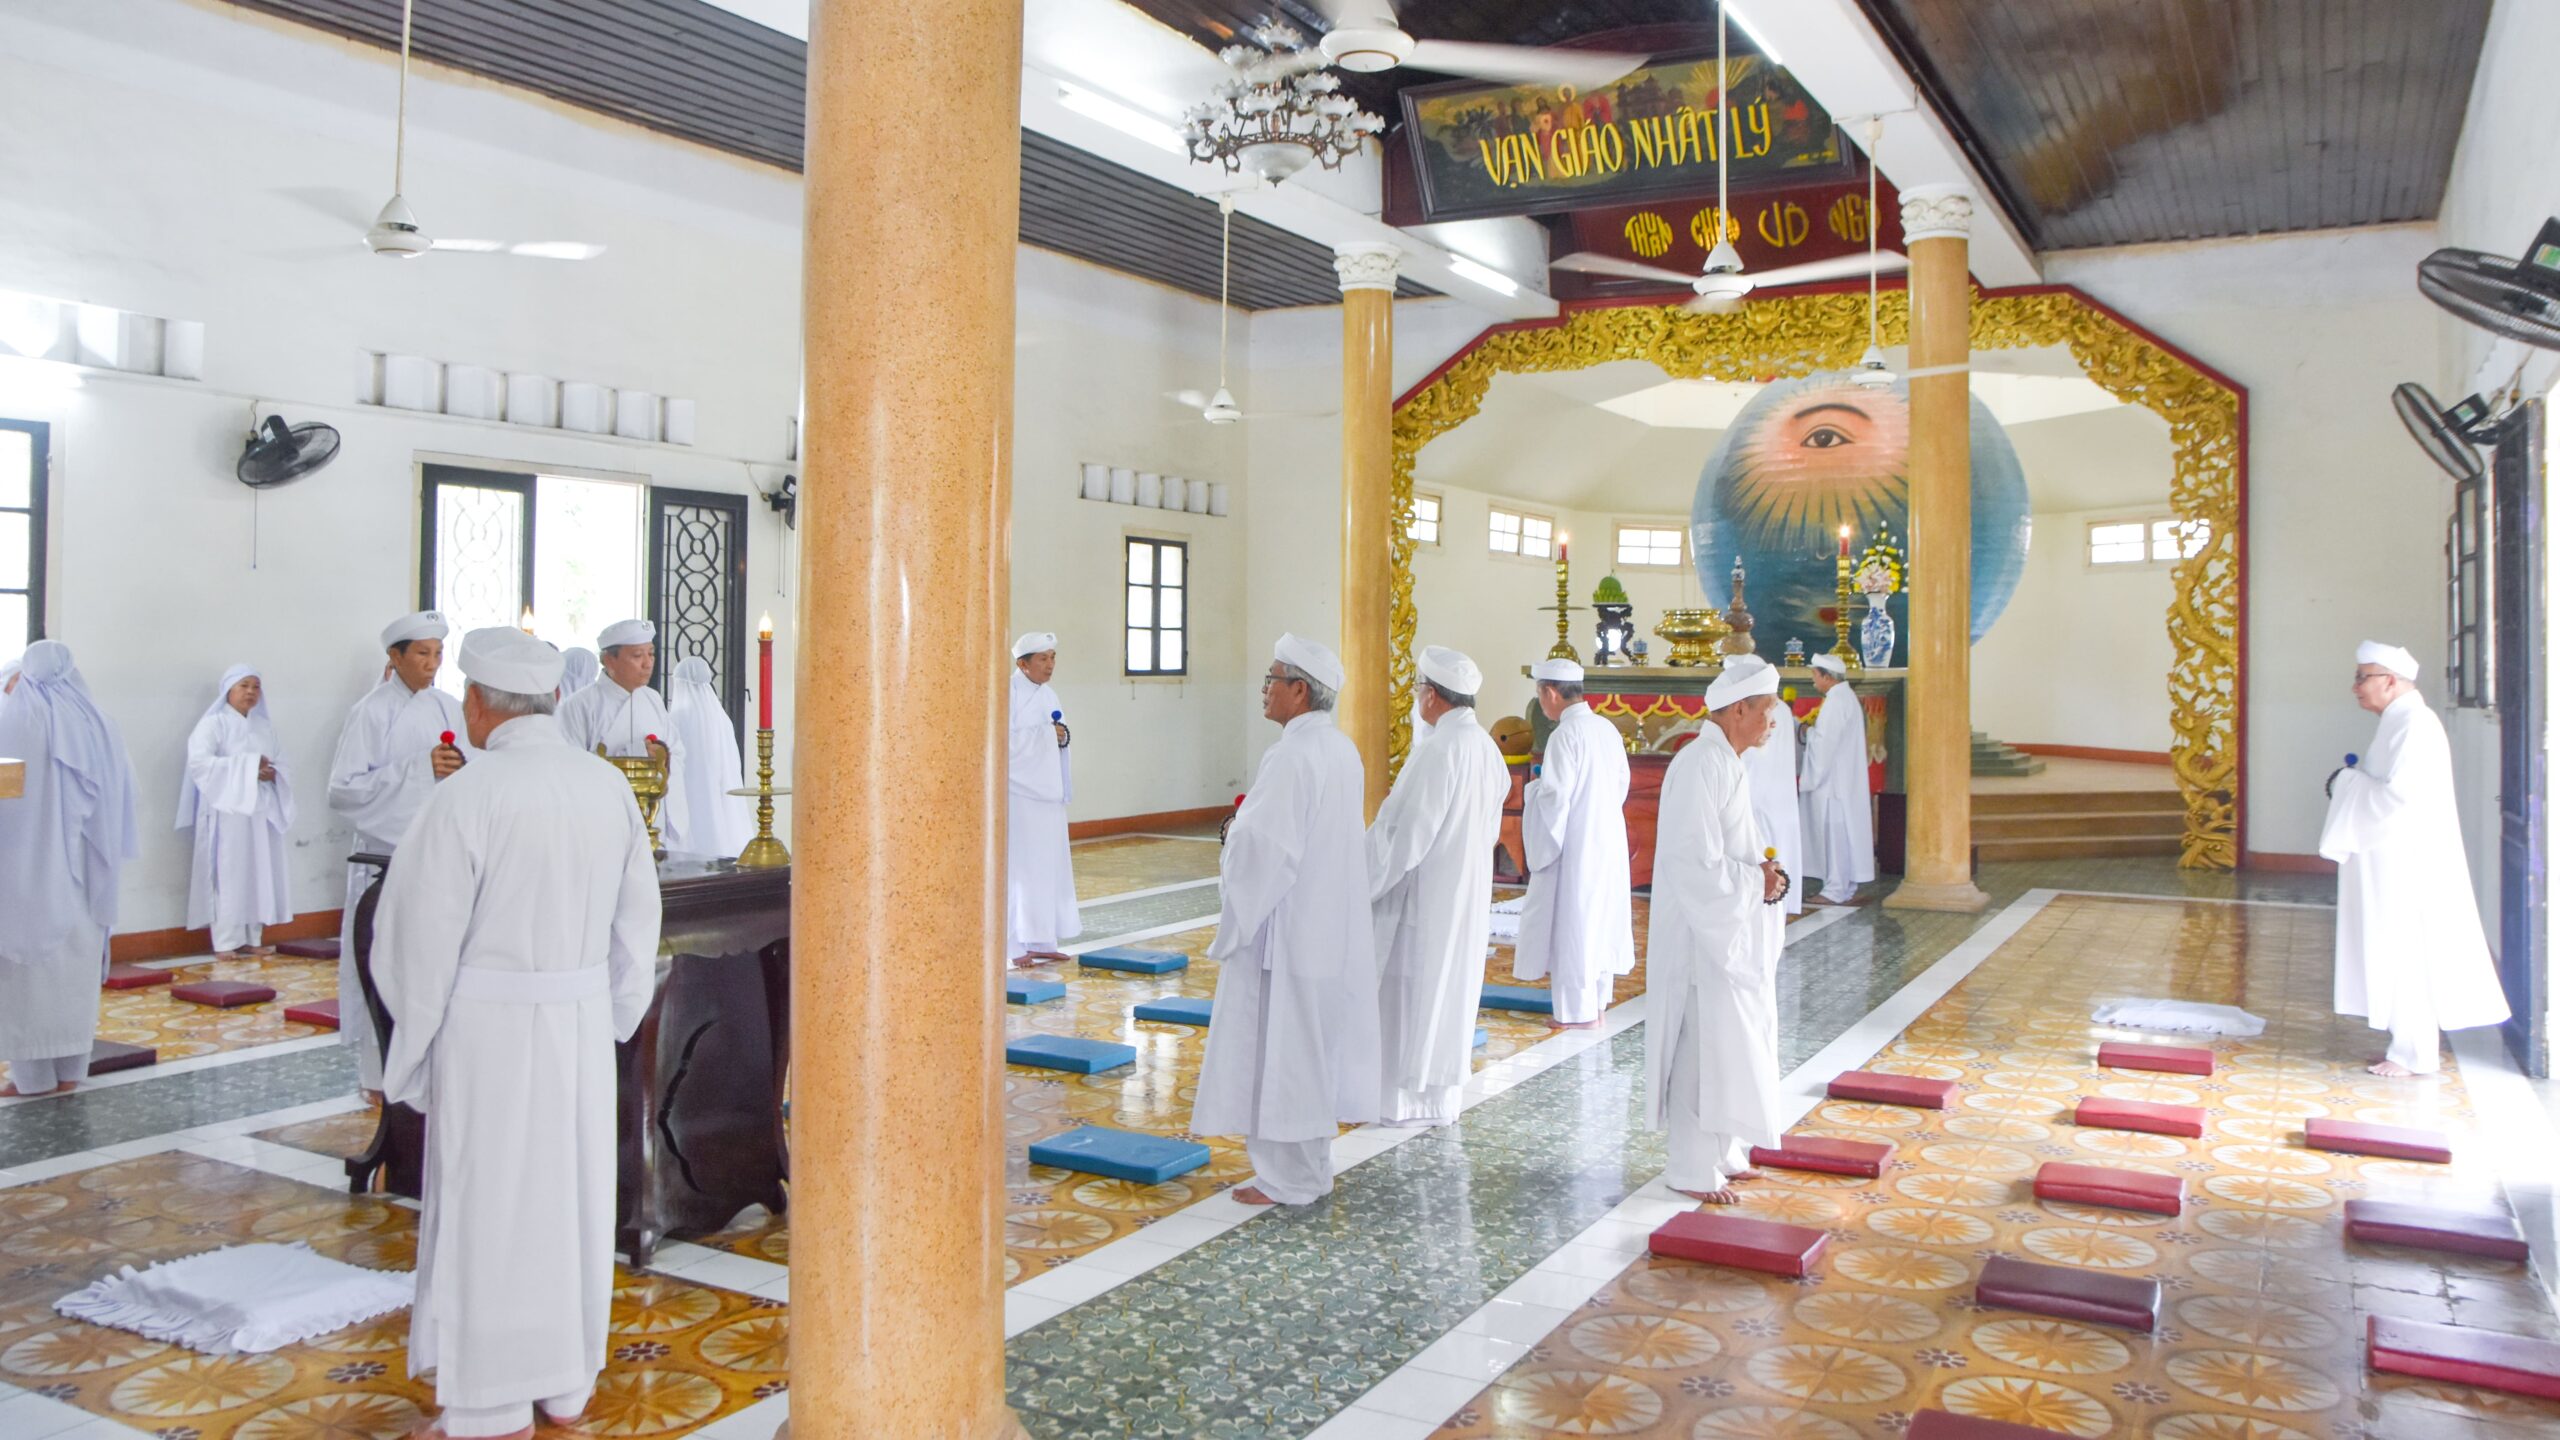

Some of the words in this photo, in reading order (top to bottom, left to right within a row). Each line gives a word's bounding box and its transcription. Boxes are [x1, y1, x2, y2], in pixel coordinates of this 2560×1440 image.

[1478, 131, 1546, 189] VẠN
[1550, 117, 1625, 179] GIÁO
[1628, 104, 1718, 171] NHẤT
[1730, 95, 1773, 160] LÝ
